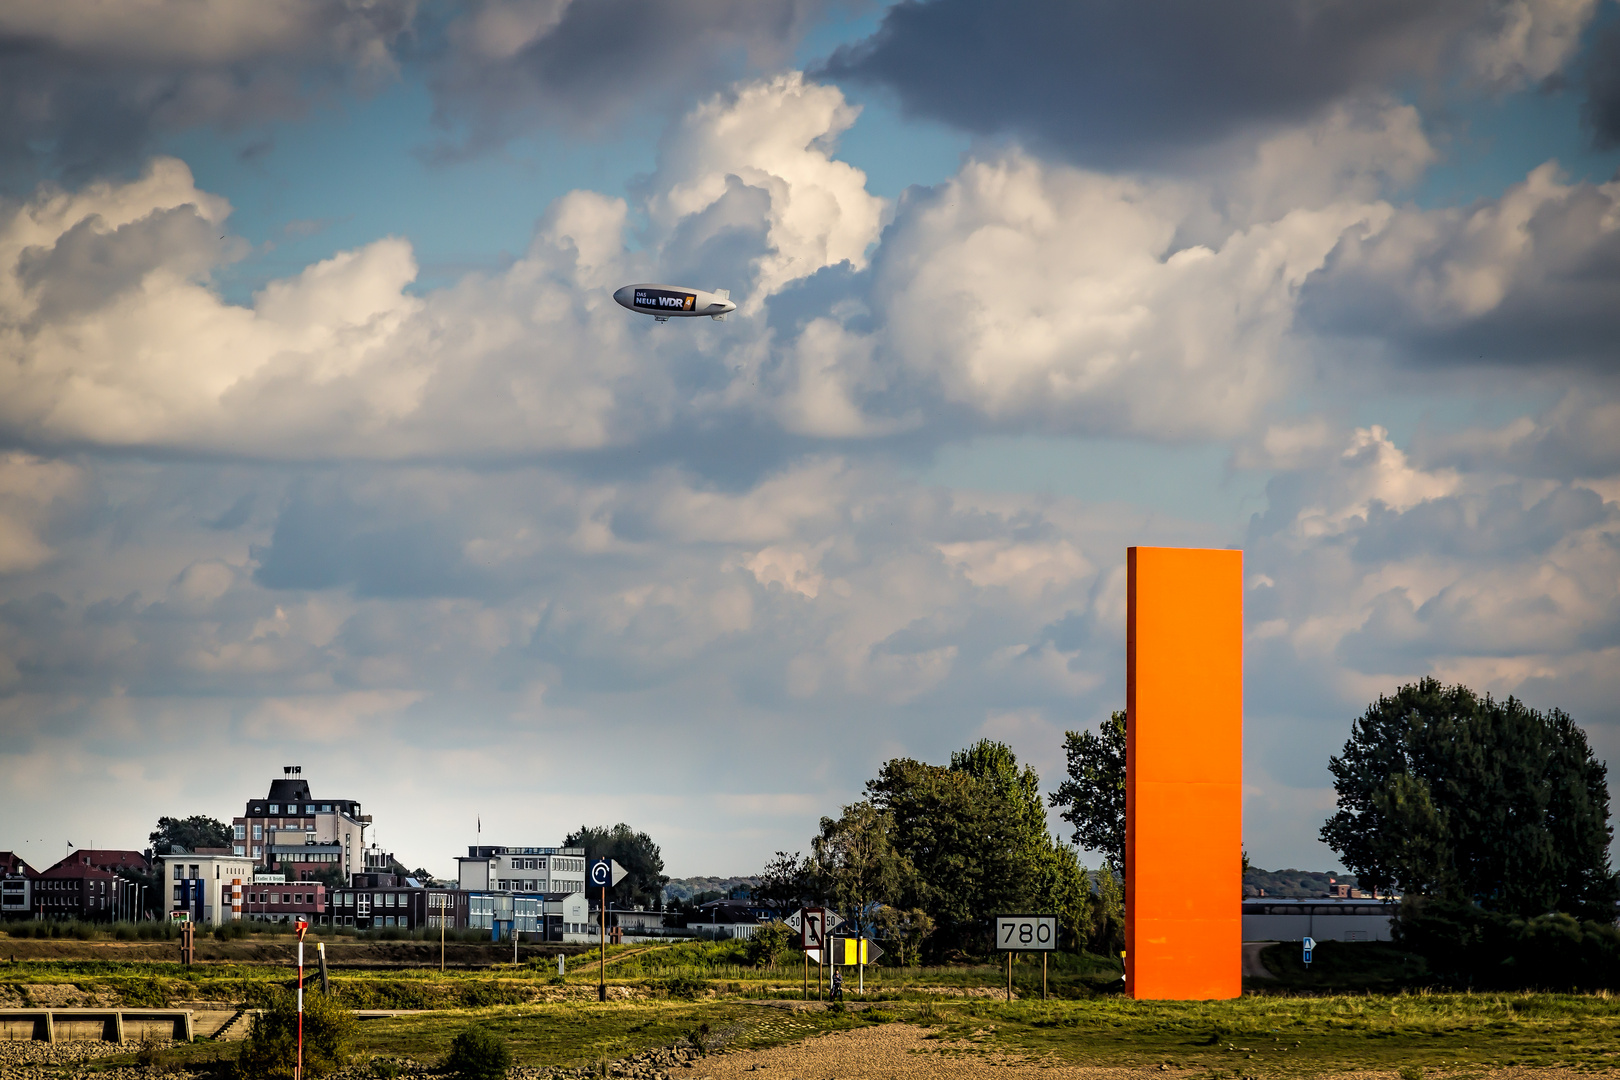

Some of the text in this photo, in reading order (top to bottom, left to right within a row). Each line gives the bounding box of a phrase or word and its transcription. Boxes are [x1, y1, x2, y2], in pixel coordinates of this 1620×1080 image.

[658, 297, 683, 308] WDR
[791, 916, 800, 927] 50
[826, 916, 836, 927] 50
[1001, 923, 1051, 944] 780
